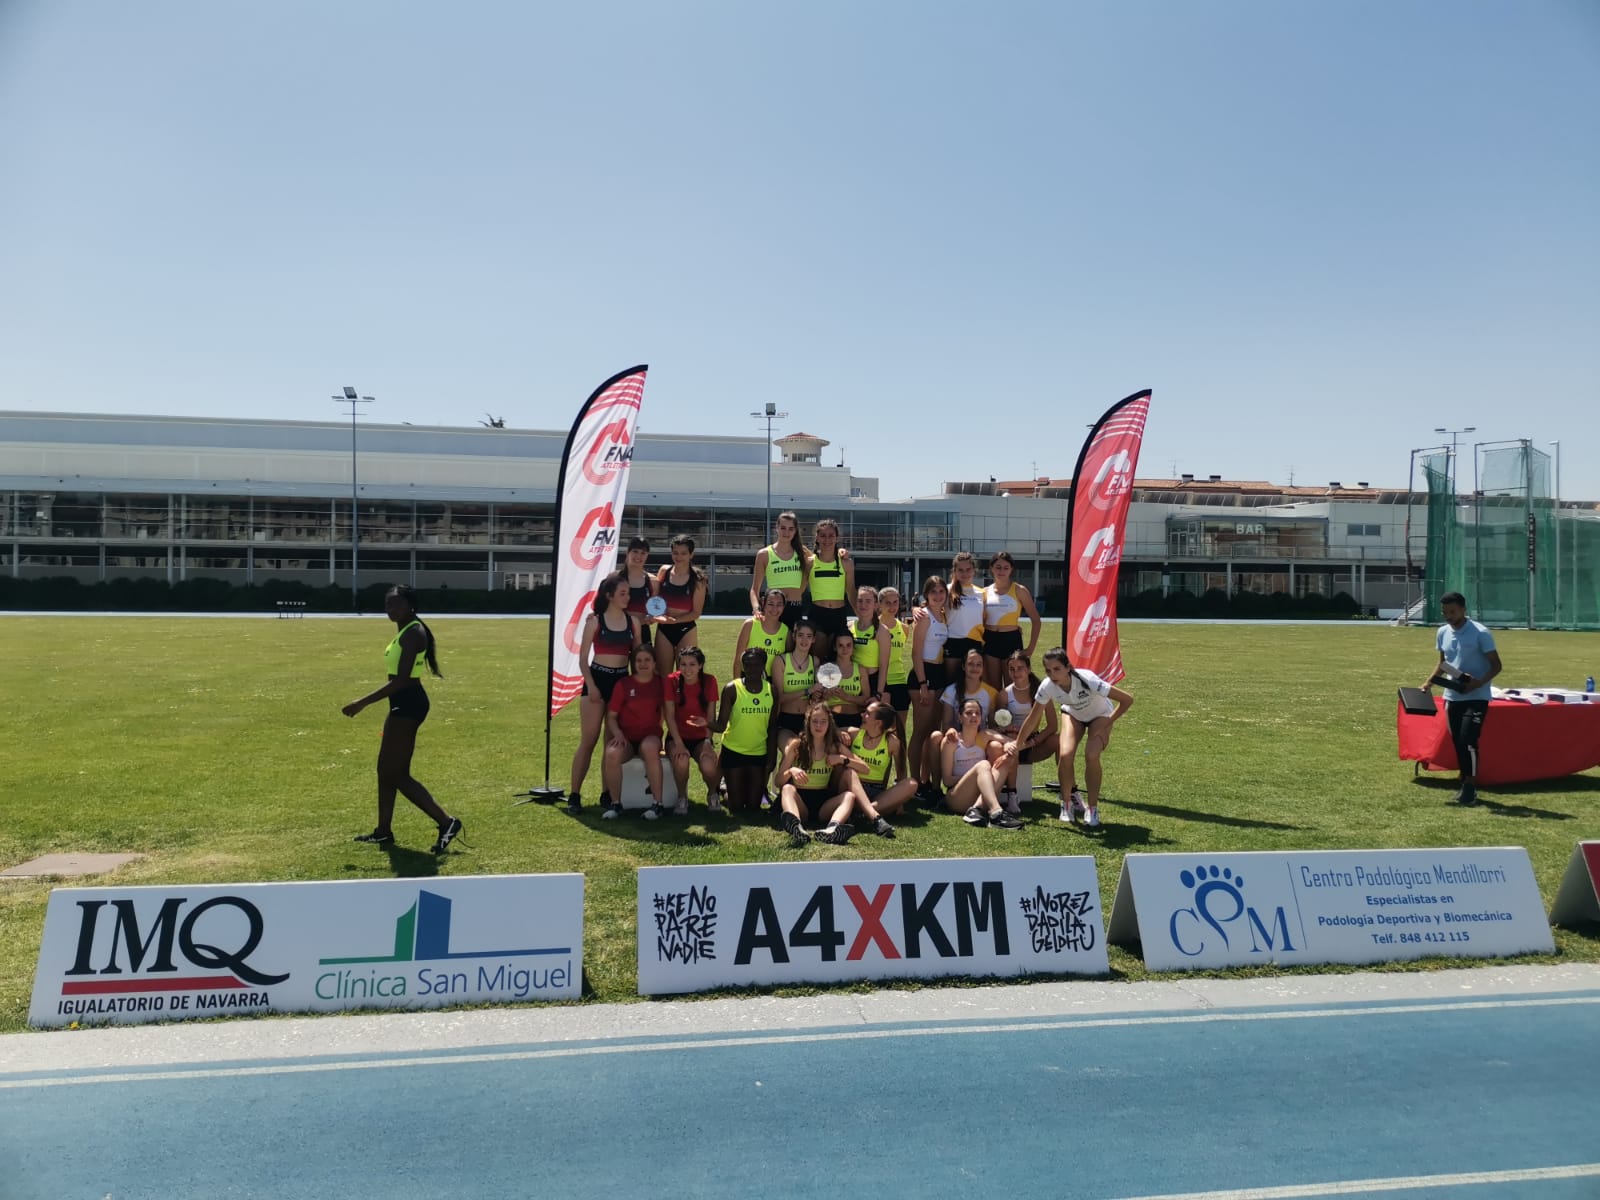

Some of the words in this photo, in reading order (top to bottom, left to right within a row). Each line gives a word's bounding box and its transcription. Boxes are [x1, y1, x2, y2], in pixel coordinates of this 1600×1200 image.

[1236, 523, 1265, 535] BAR
[1300, 865, 1354, 888] Centro
[1354, 865, 1432, 890] Podológico
[1432, 863, 1507, 885] Mendillorri
[1366, 894, 1438, 907] Especialistas
[1440, 895, 1455, 904] en
[654, 909, 718, 942] PARE
[734, 881, 1011, 965] A4XKM
[1376, 912, 1432, 926] Deportiva
[1434, 914, 1441, 925] y
[1443, 910, 1513, 923] Biomecánica
[65, 896, 290, 986] IMQ
[657, 934, 717, 964] NADIE
[1370, 933, 1398, 945] Telf.
[1400, 932, 1422, 944] 848
[1424, 932, 1446, 943] 412
[1448, 931, 1470, 942] 115
[315, 970, 407, 1000] Clínica
[417, 968, 468, 995] San
[477, 960, 572, 998] Miguel
[57, 997, 164, 1015] IGUALATORIO
[169, 996, 190, 1010] DE
[196, 992, 270, 1009] NAVARRA
